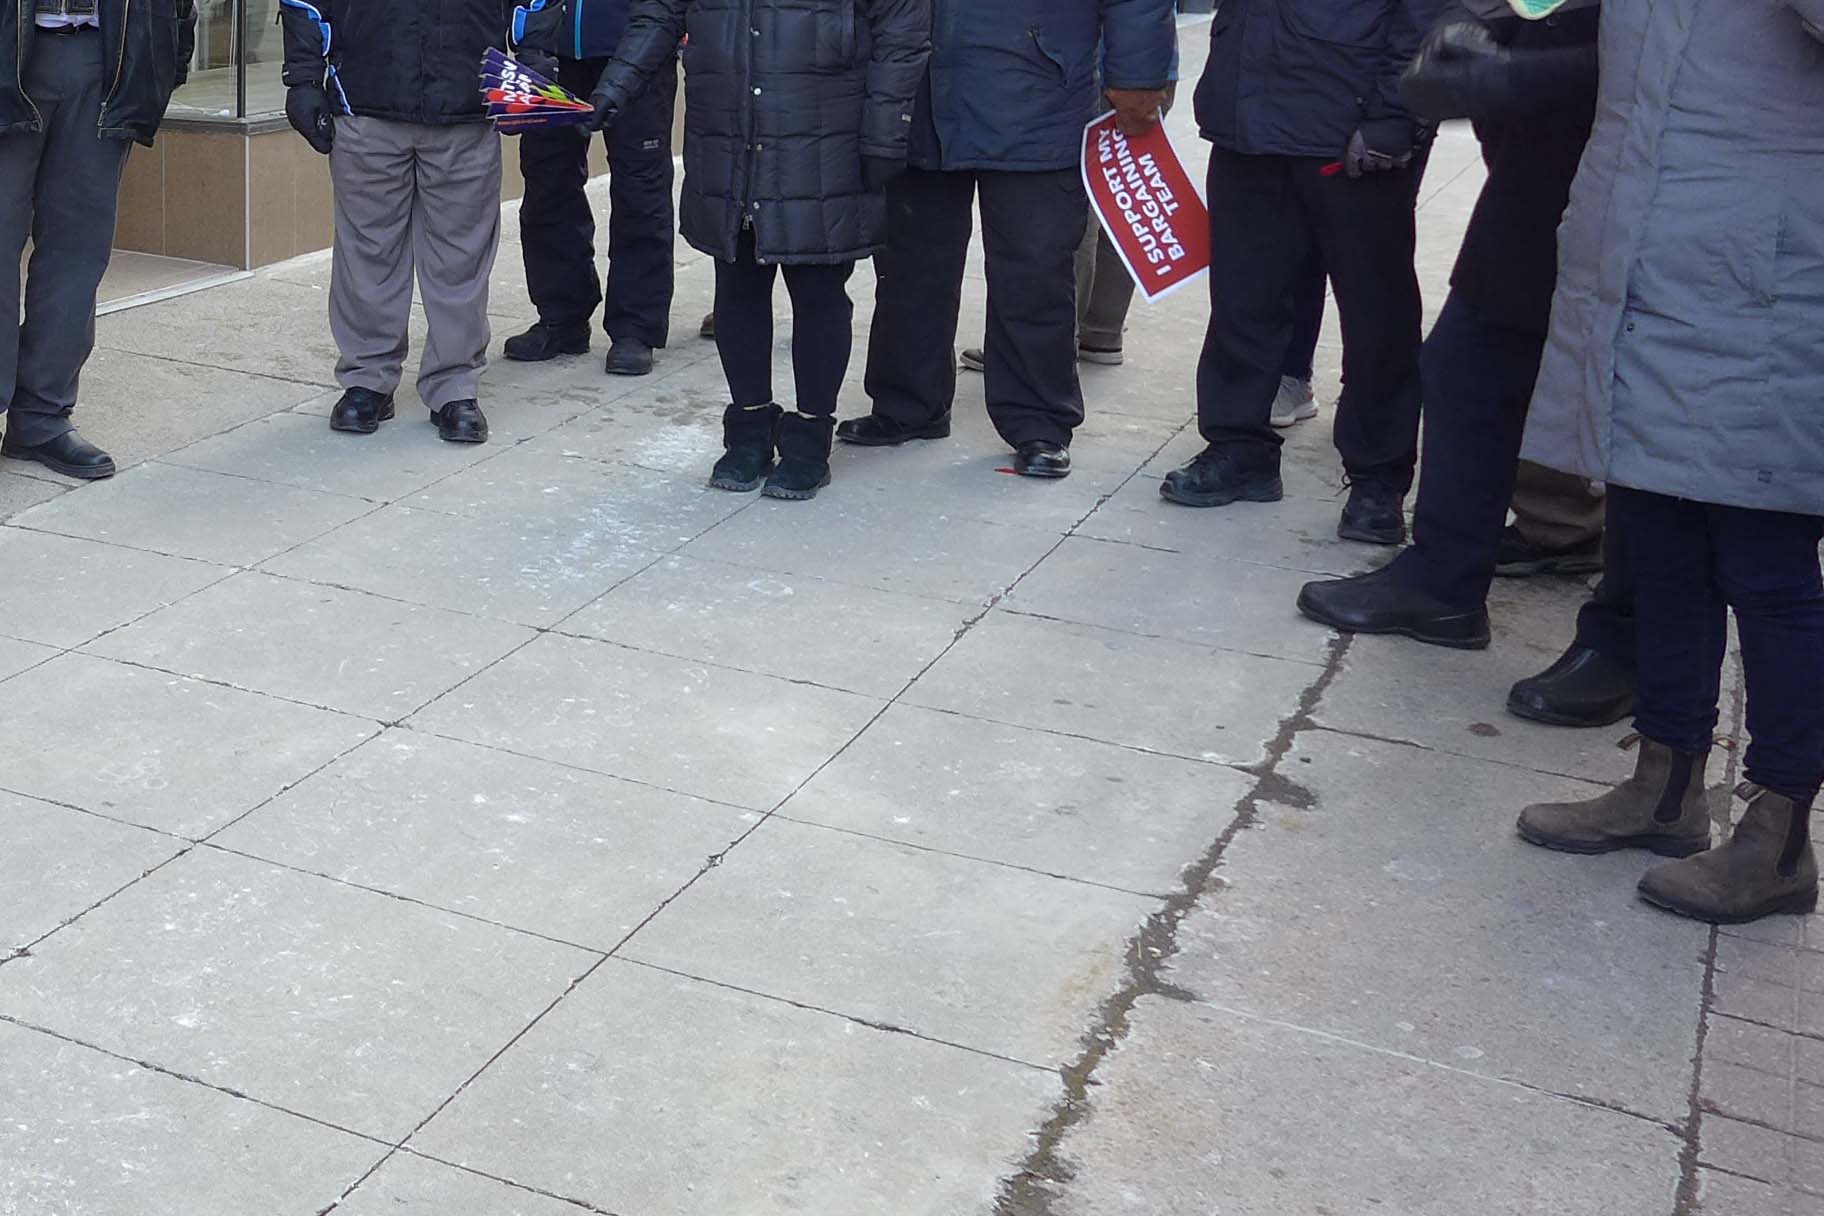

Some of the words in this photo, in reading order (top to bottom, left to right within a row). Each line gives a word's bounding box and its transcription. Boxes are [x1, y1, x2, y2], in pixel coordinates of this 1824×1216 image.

[1098, 130, 1113, 164] MY
[1138, 153, 1180, 216] TEAM
[1103, 167, 1165, 264] SUPPORT
[1156, 264, 1172, 276] I
